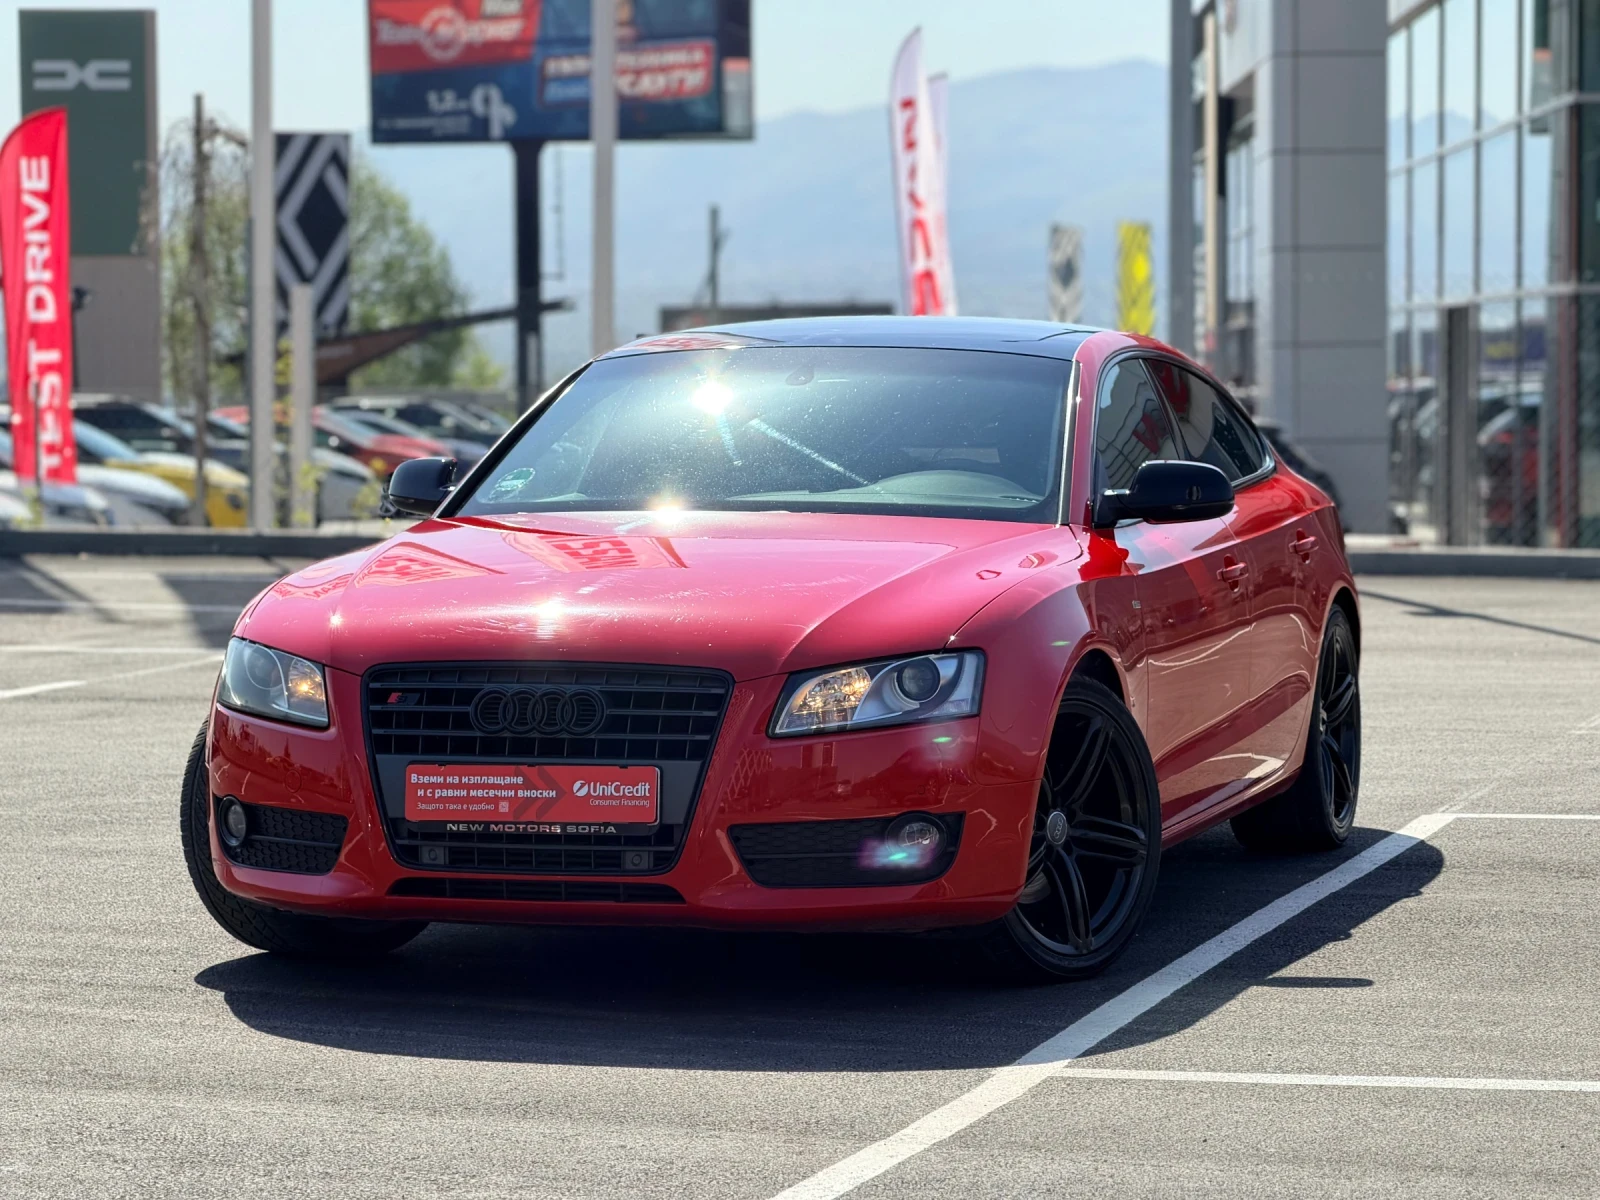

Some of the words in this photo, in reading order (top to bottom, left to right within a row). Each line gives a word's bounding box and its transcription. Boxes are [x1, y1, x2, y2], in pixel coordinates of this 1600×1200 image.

[19, 155, 57, 323] DRIVE
[410, 773, 444, 784] Вземи
[446, 775, 460, 784] на
[462, 775, 524, 786] изплащане
[417, 788, 424, 797] и
[426, 788, 432, 797] с
[435, 789, 467, 799] равни
[469, 789, 515, 798] месечни
[517, 789, 557, 799] вноски
[589, 781, 650, 797] UniCredit
[416, 802, 444, 811] Защото
[469, 802, 495, 811] удобно
[589, 798, 620, 806] Consumer
[621, 798, 650, 808] Financing
[446, 823, 484, 832] NEW
[490, 824, 561, 833] MOTORS
[566, 825, 617, 834] SOFIA
